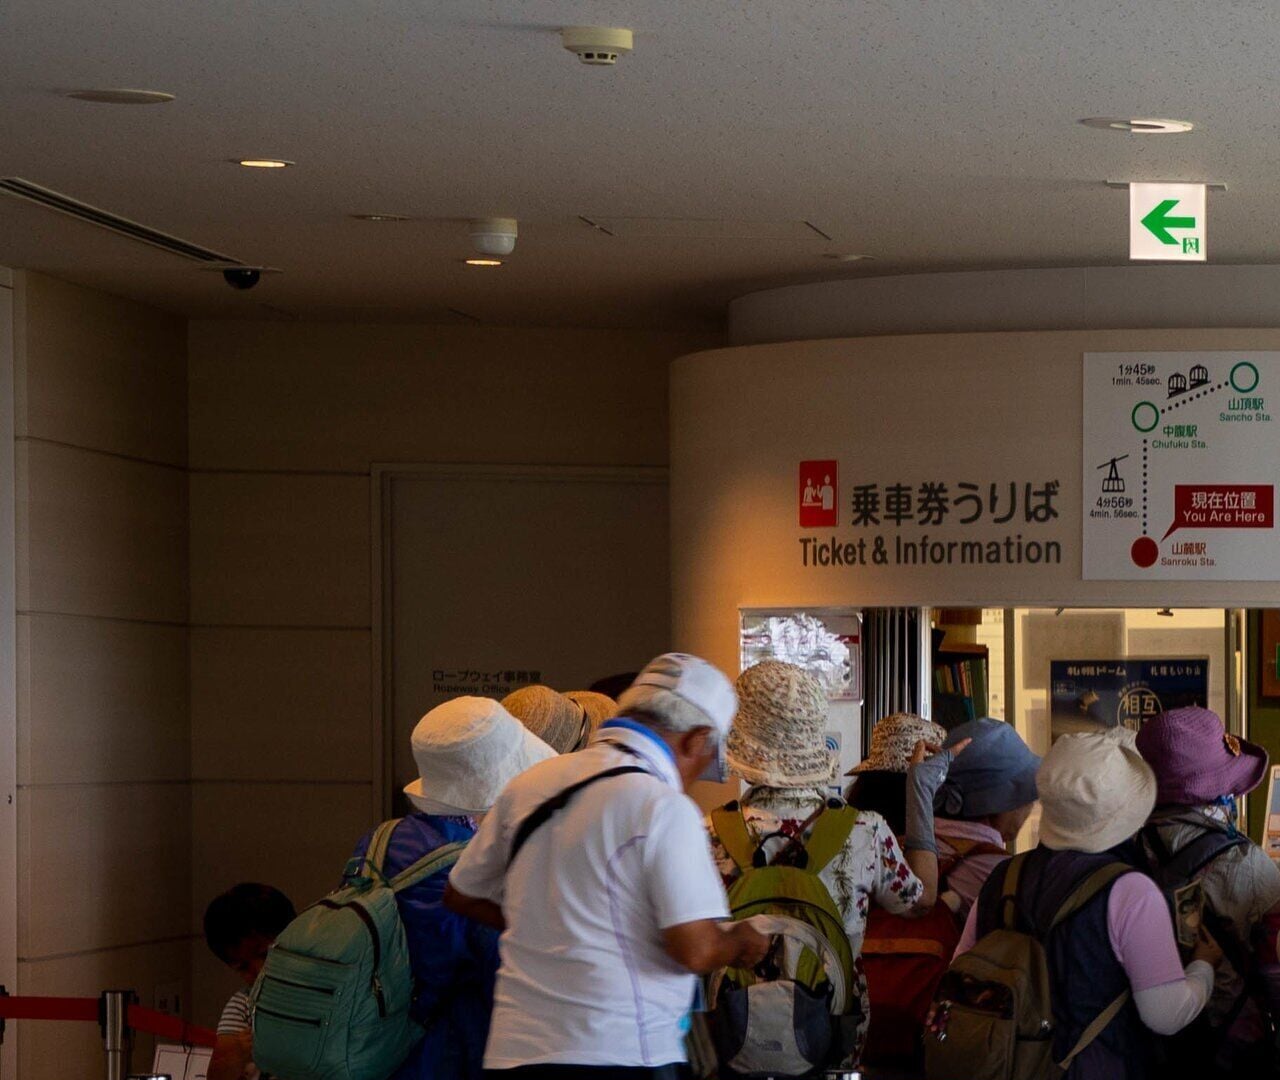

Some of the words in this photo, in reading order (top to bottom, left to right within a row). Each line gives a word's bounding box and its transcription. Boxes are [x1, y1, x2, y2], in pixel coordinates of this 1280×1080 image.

[1118, 363, 1156, 376] 1分45秒
[1228, 398, 1264, 411] 山頂駅
[1219, 412, 1253, 422] Sancho
[1255, 412, 1273, 422] Sta.
[1162, 425, 1198, 438] 中腹駅
[1152, 440, 1190, 450] Chufuku
[1191, 440, 1209, 450] Sta.
[851, 480, 1060, 527] 乗車券うりば
[1096, 496, 1134, 509] 4分56秒
[1191, 491, 1257, 510] 現在位置
[1183, 510, 1206, 522] You
[1209, 510, 1232, 522] Are
[1235, 510, 1266, 522] Here
[799, 536, 867, 566] Ticket
[872, 536, 889, 565] &
[896, 534, 1062, 565] Information
[1171, 542, 1207, 555] 山麓駅
[1161, 557, 1198, 567] Sanroku
[1200, 557, 1217, 567] Sta.
[1123, 694, 1157, 715] 相互
